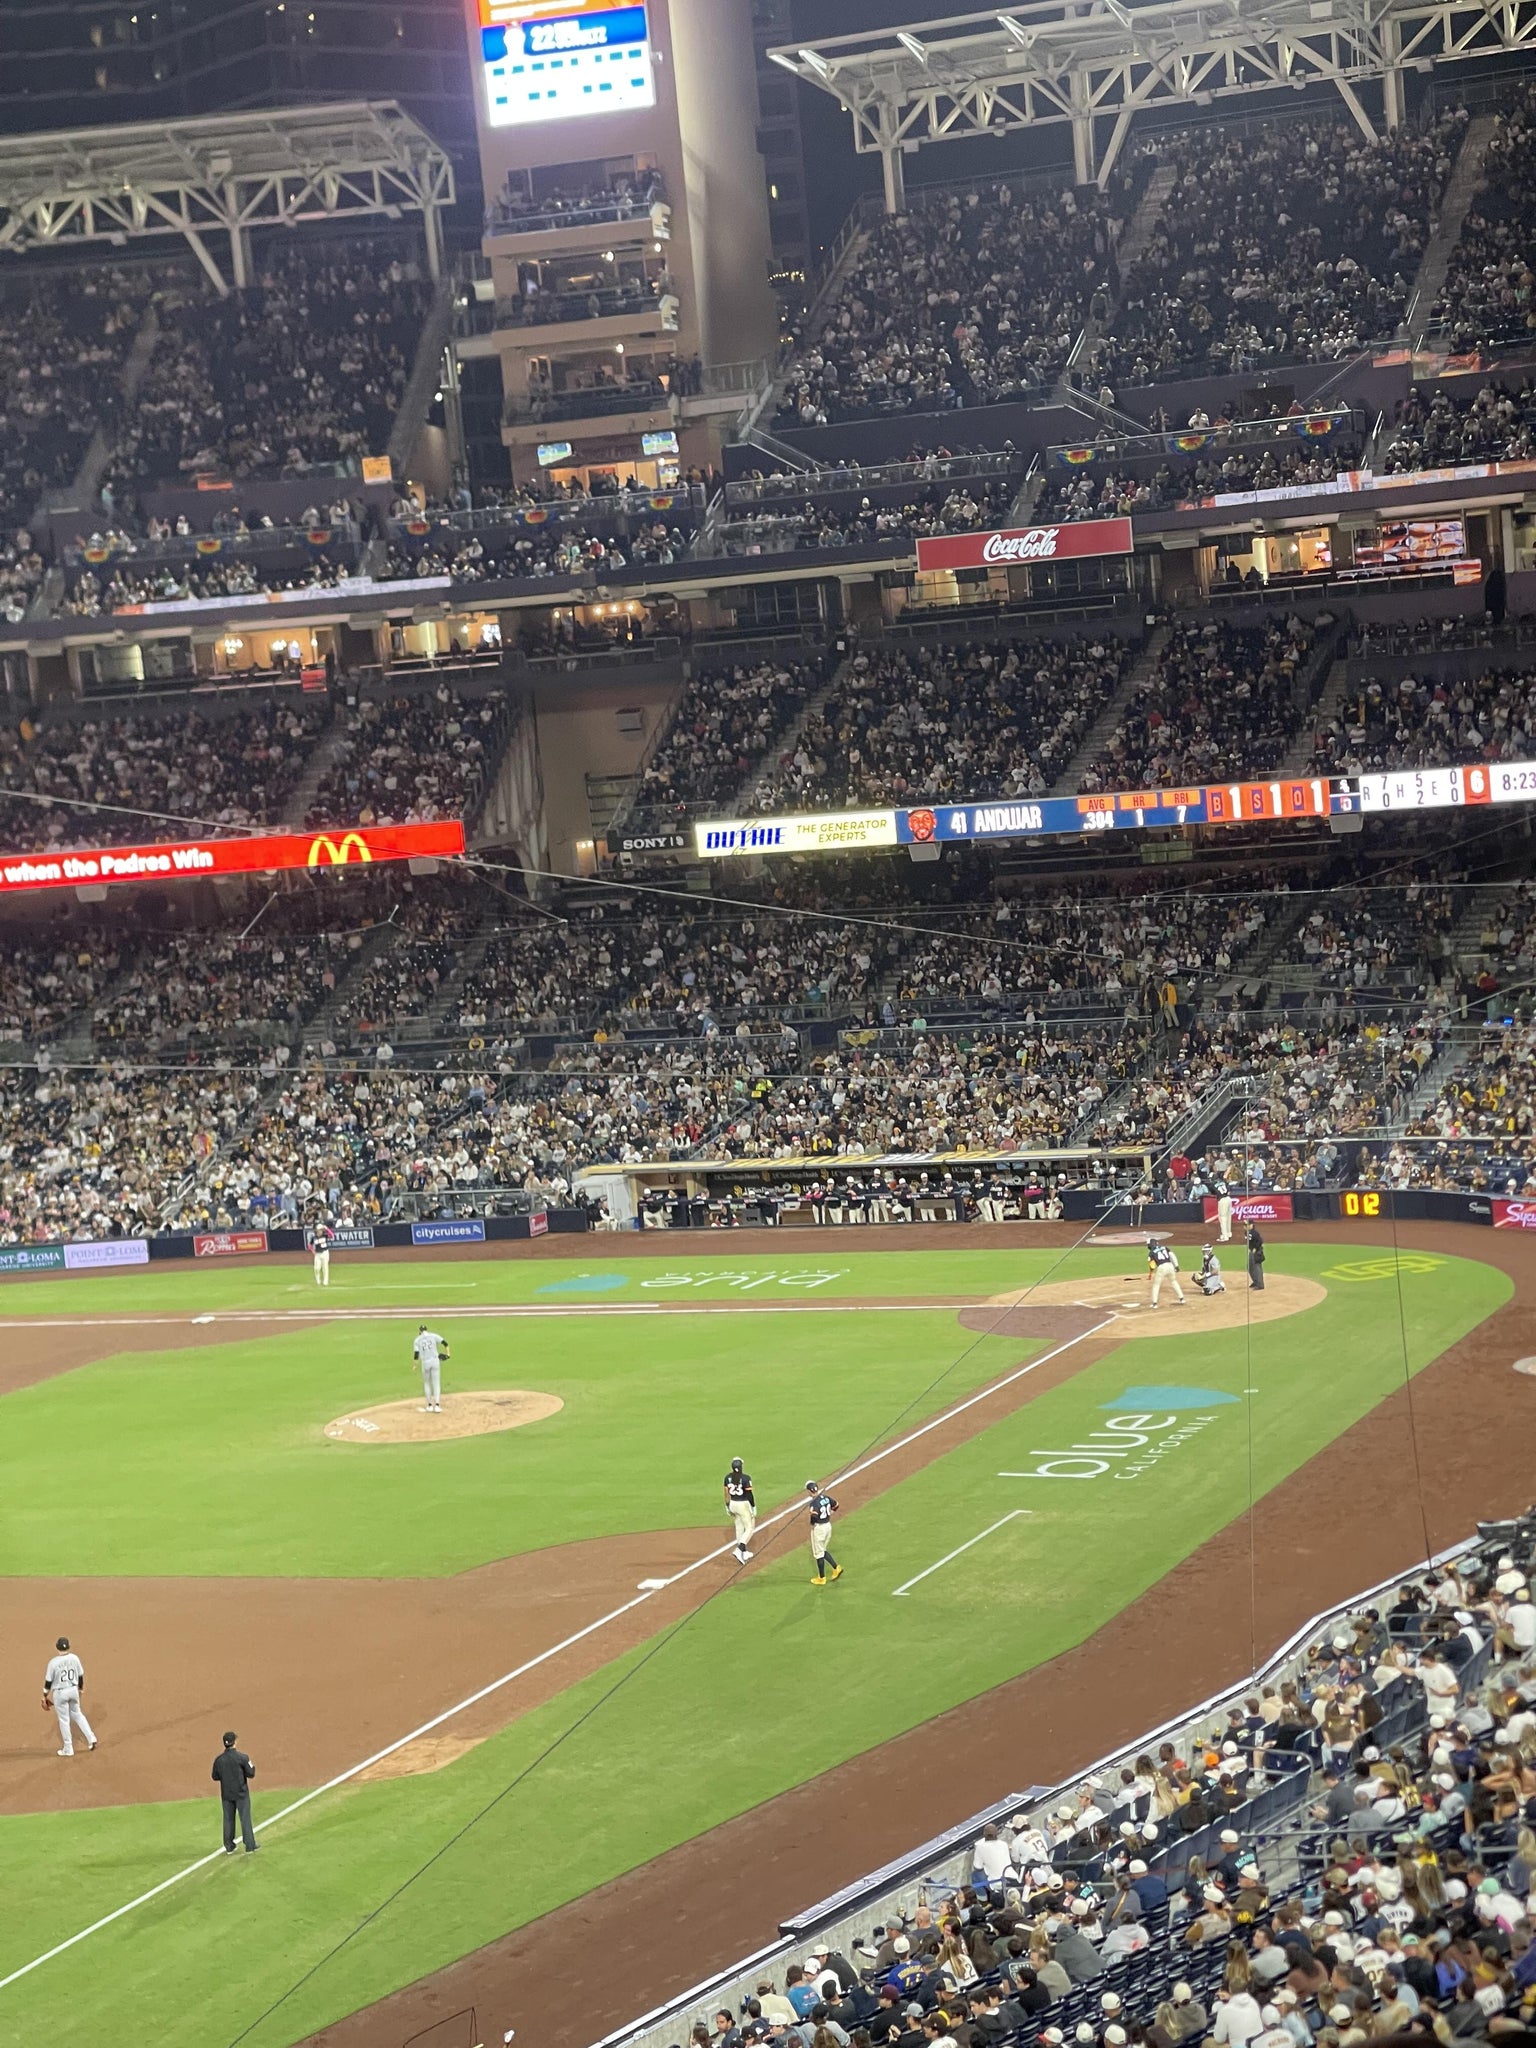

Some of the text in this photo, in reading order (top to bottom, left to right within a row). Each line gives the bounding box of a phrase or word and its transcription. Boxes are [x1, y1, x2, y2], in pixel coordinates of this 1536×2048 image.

[983, 528, 1060, 562] Coca-Cola
[1381, 776, 1388, 790] 7
[1415, 773, 1423, 787] 5
[1449, 770, 1457, 785] 0
[1470, 769, 1485, 794] 6
[1502, 772, 1536, 791] 8:23
[1363, 786, 1371, 800] R
[1396, 784, 1404, 798] H
[1431, 781, 1438, 795] E
[1451, 787, 1459, 803] 0
[1132, 795, 1145, 806] HR
[1174, 791, 1189, 804] RBI
[1213, 787, 1242, 818] B 1
[1253, 784, 1283, 816] S 1
[1310, 780, 1323, 812] 1
[1383, 793, 1390, 808] 0
[1417, 790, 1424, 805] 2
[1088, 799, 1105, 811] AVG
[1083, 810, 1114, 830] .304
[1135, 808, 1144, 826] 1
[1177, 805, 1187, 823] 7
[796, 819, 888, 835] THE GENERATOR
[951, 811, 968, 834] 41
[623, 837, 667, 850] SONY
[818, 832, 867, 844] EXPERTS
[4, 847, 214, 883] when the Padres Win
[416, 1226, 472, 1240] citycruises
[28, 1252, 60, 1263] LOMA
[71, 1248, 102, 1259] POINT
[997, 1414, 1177, 1479] blue
[1114, 1415, 1219, 1480] CALIFORNIA
[60, 1668, 75, 1683] 20
